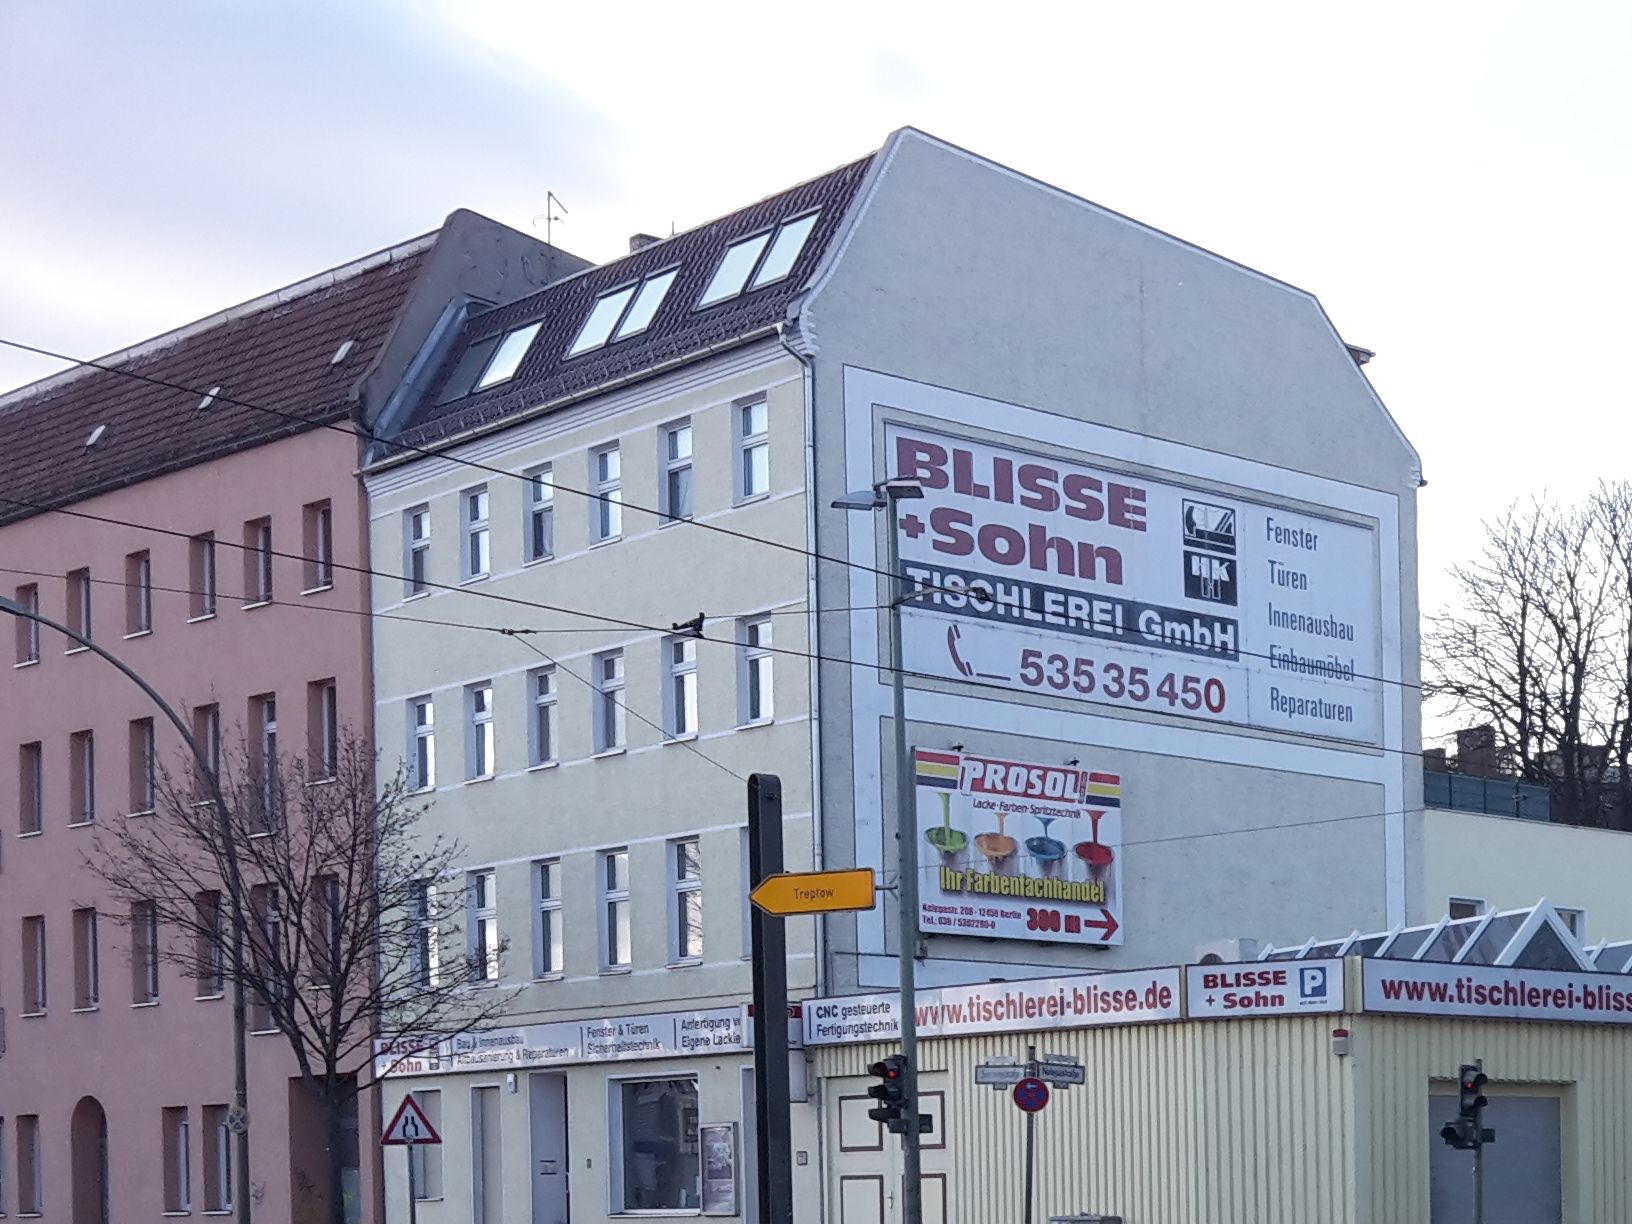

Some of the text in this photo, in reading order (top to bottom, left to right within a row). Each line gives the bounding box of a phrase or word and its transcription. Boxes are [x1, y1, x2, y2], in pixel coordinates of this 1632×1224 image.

[896, 436, 1148, 532] BLISSE
[1266, 517, 1319, 552] Fenster
[1268, 559, 1308, 592] Türen
[906, 567, 1236, 655] TISCHLEREI GmbH
[1268, 601, 1355, 643] Innenausbau
[1269, 645, 1356, 682] Einbaumöbel
[1270, 687, 1354, 724] Reparaturen
[959, 758, 1081, 800] PROSOL
[939, 866, 963, 892] Ihr
[1203, 970, 1287, 989] BLISSE
[816, 1002, 891, 1020] CNC gesteuerte
[914, 981, 1172, 1028] www.tischlerei-blisse.de
[1222, 990, 1285, 1009] Sohn
[625, 1023, 650, 1035] Türen
[681, 1018, 731, 1034] Anfertigung
[712, 1033, 741, 1046] Lackie
[816, 1018, 899, 1039] Fertigungstechnik
